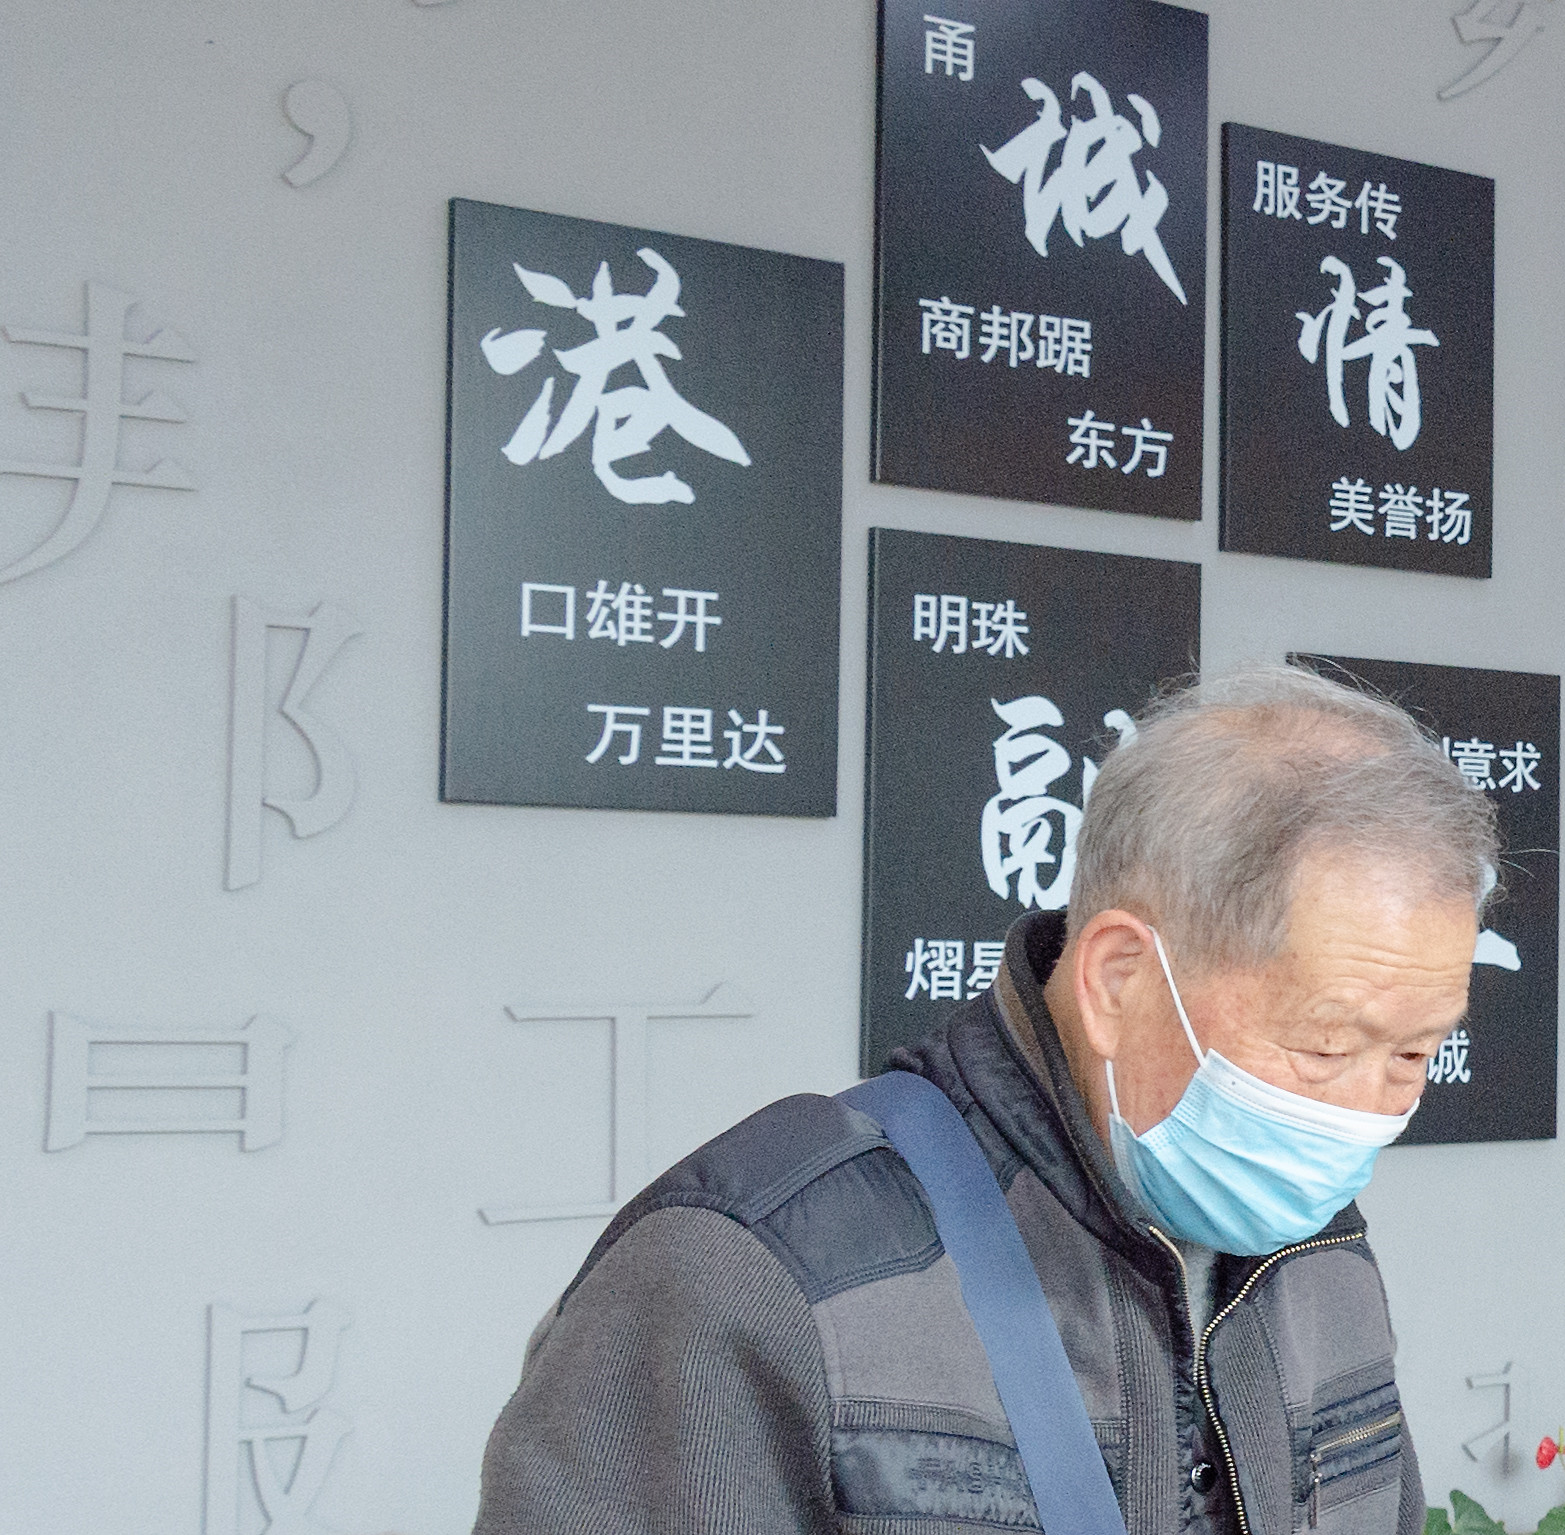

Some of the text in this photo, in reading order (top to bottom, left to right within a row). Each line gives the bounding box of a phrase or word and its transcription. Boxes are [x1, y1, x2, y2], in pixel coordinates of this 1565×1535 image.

[924, 15, 976, 81] 甬
[980, 71, 1187, 305] 诚
[1253, 160, 1402, 240] 服务传
[918, 296, 1093, 378] 商邦踞
[1296, 256, 1440, 451] 情
[480, 248, 752, 505] 港
[1066, 410, 1174, 477] 东方
[1329, 476, 1472, 545] 美誉扬
[520, 580, 722, 653] 口雄开
[913, 594, 1029, 659] 明珠
[585, 703, 787, 774] 万里达
